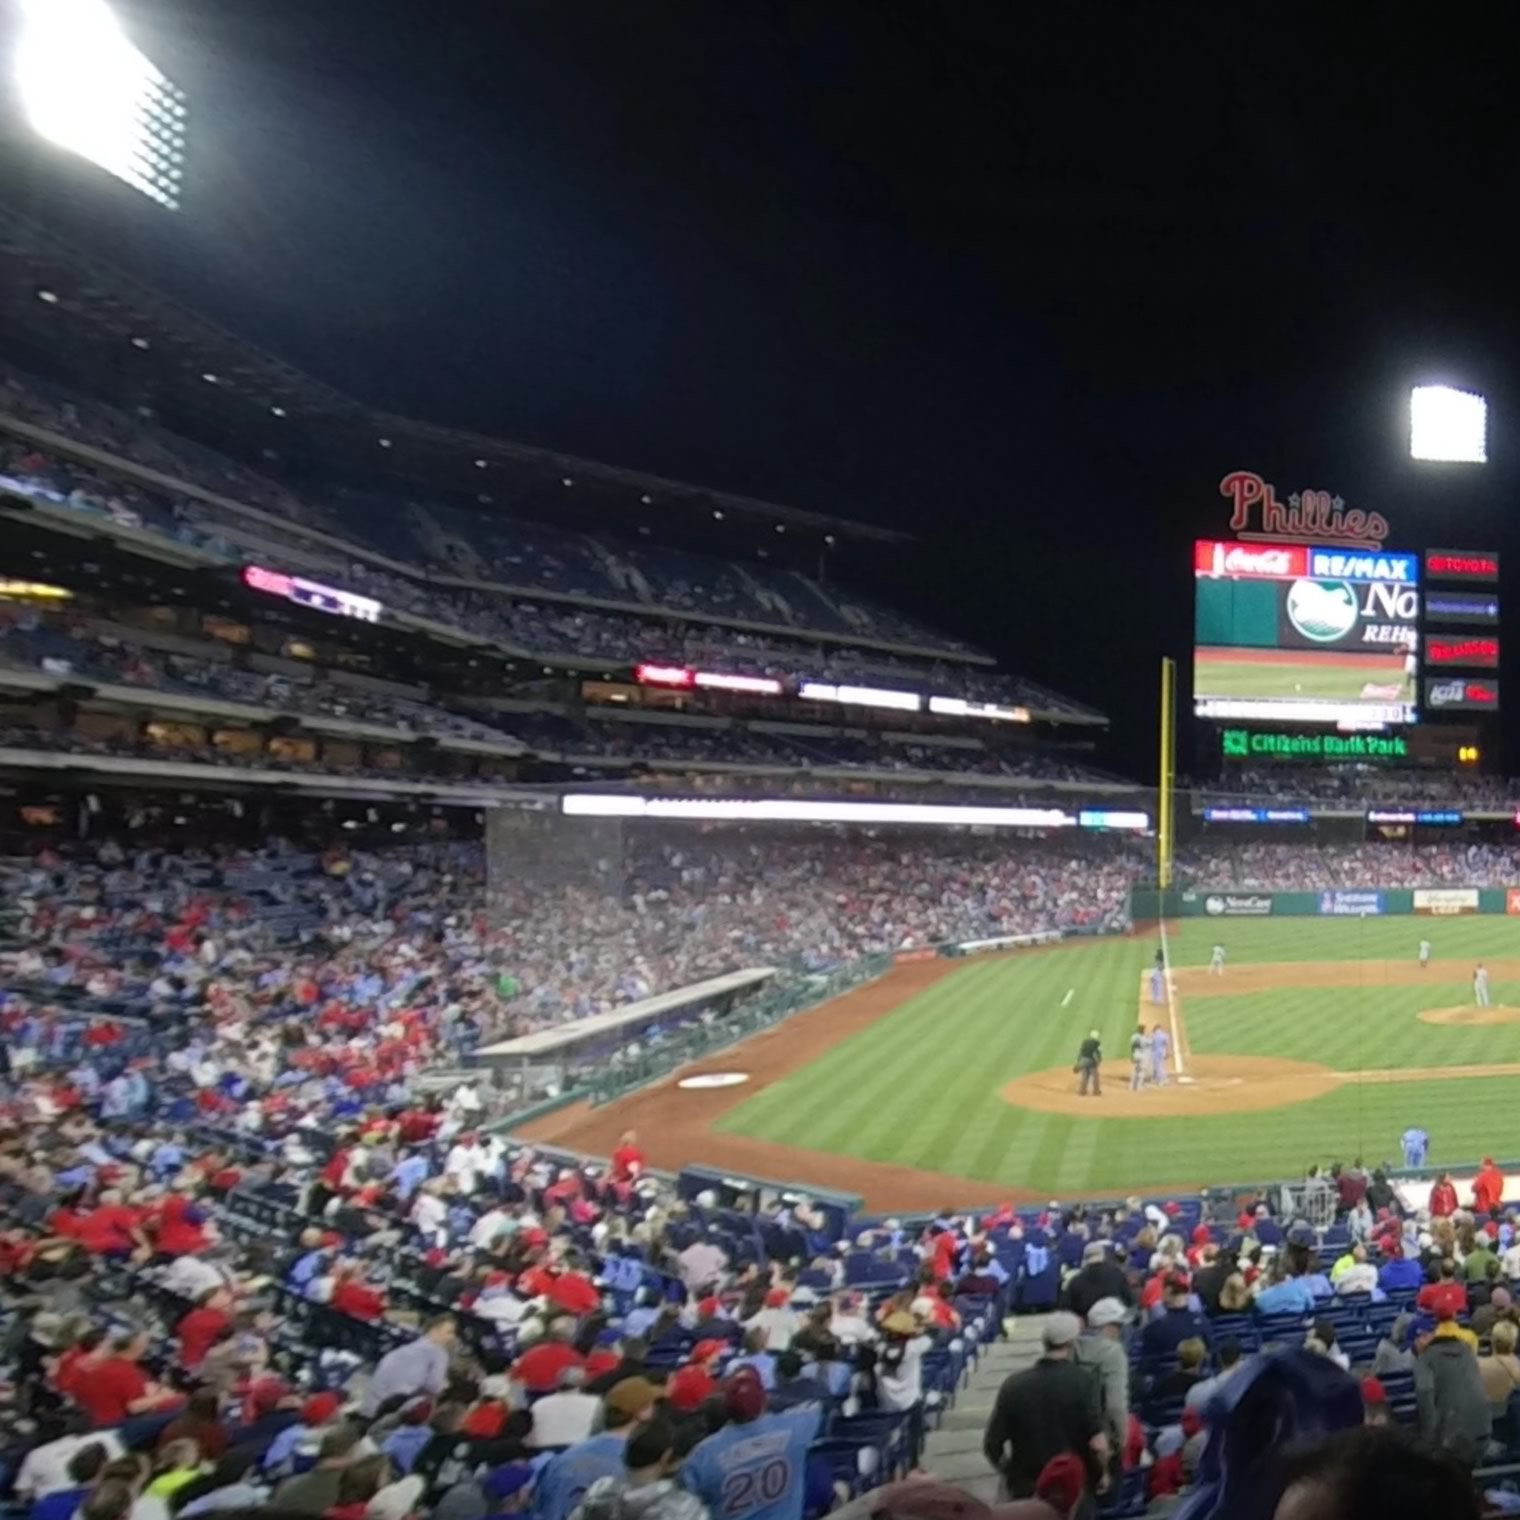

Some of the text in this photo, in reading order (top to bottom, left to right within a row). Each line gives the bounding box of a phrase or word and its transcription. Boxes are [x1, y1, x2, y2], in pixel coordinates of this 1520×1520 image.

[1219, 471, 1389, 541] Phillies
[1314, 555, 1409, 579] RE/MAX
[1362, 624, 1418, 643] REH
[1251, 734, 1407, 755] Citizens Bank Park
[722, 1458, 789, 1517] 20
